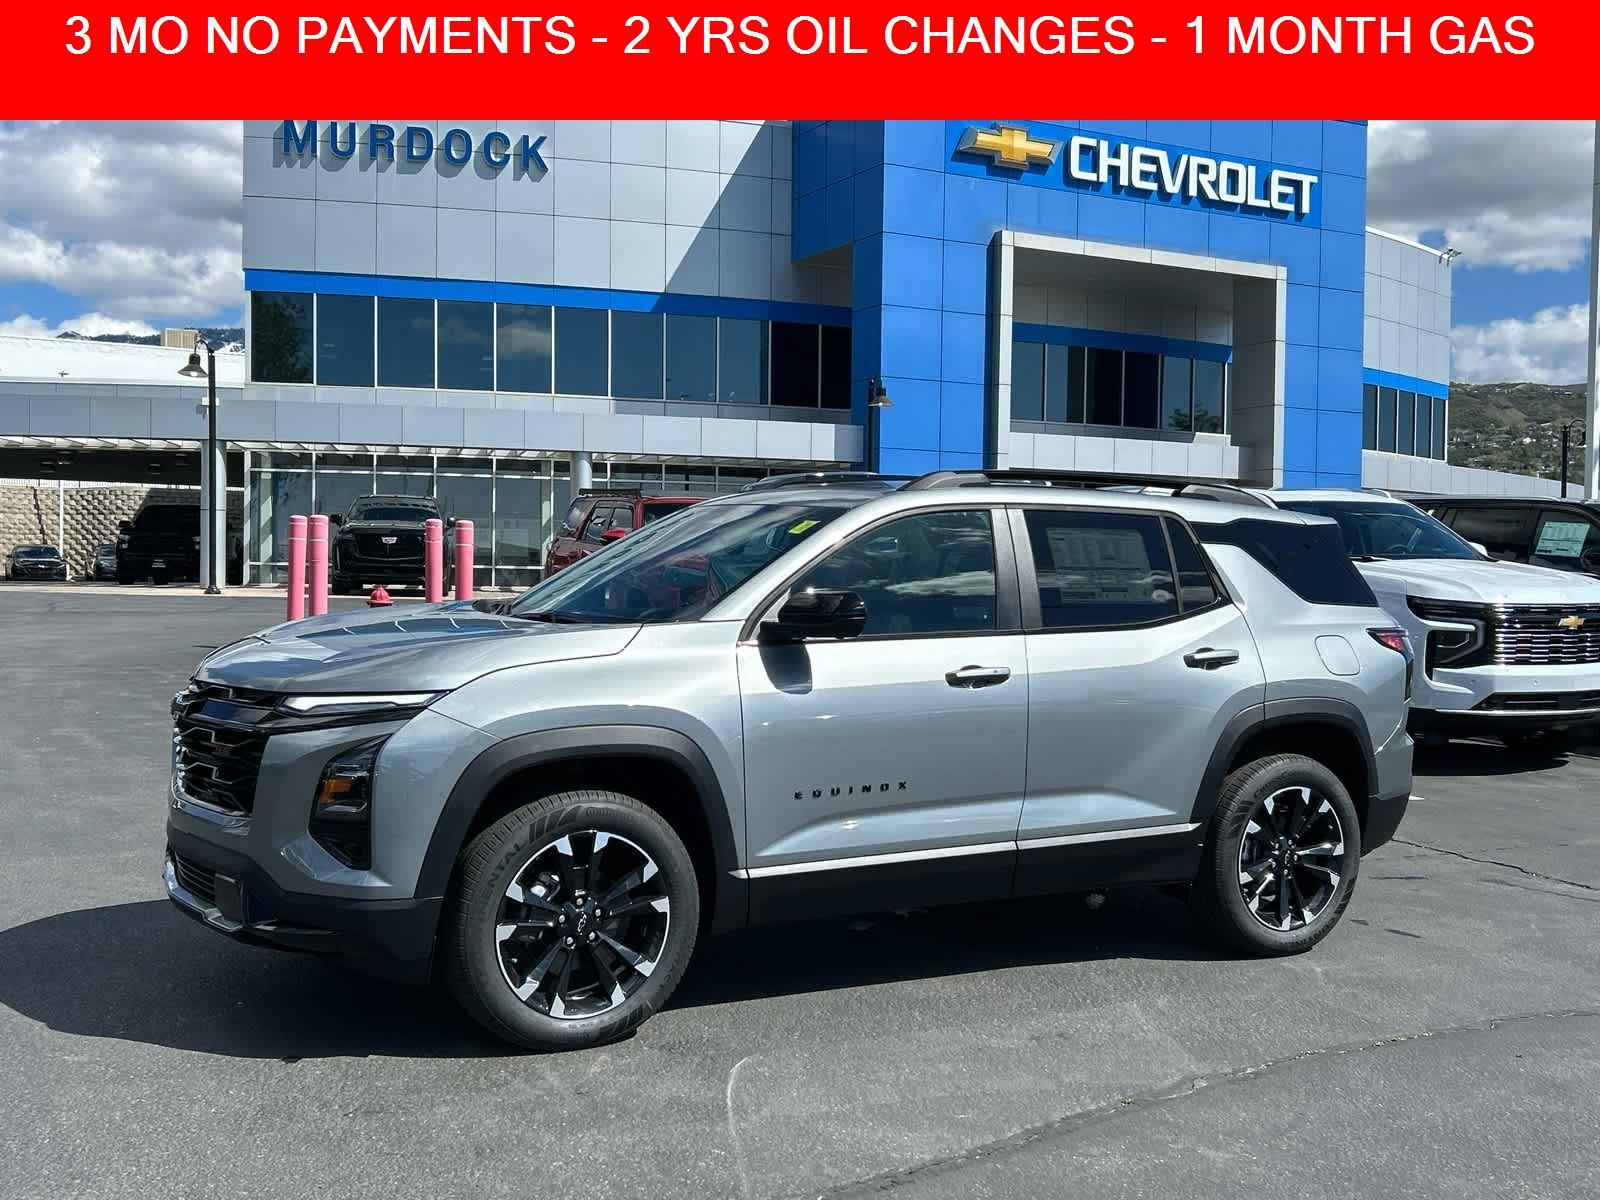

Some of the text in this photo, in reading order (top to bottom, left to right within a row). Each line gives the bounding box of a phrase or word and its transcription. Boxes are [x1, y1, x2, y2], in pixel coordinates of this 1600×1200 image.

[282, 119, 549, 172] MURDOCK
[1069, 135, 1319, 214] CHEVROLET
[793, 780, 908, 801] EQUINOX
